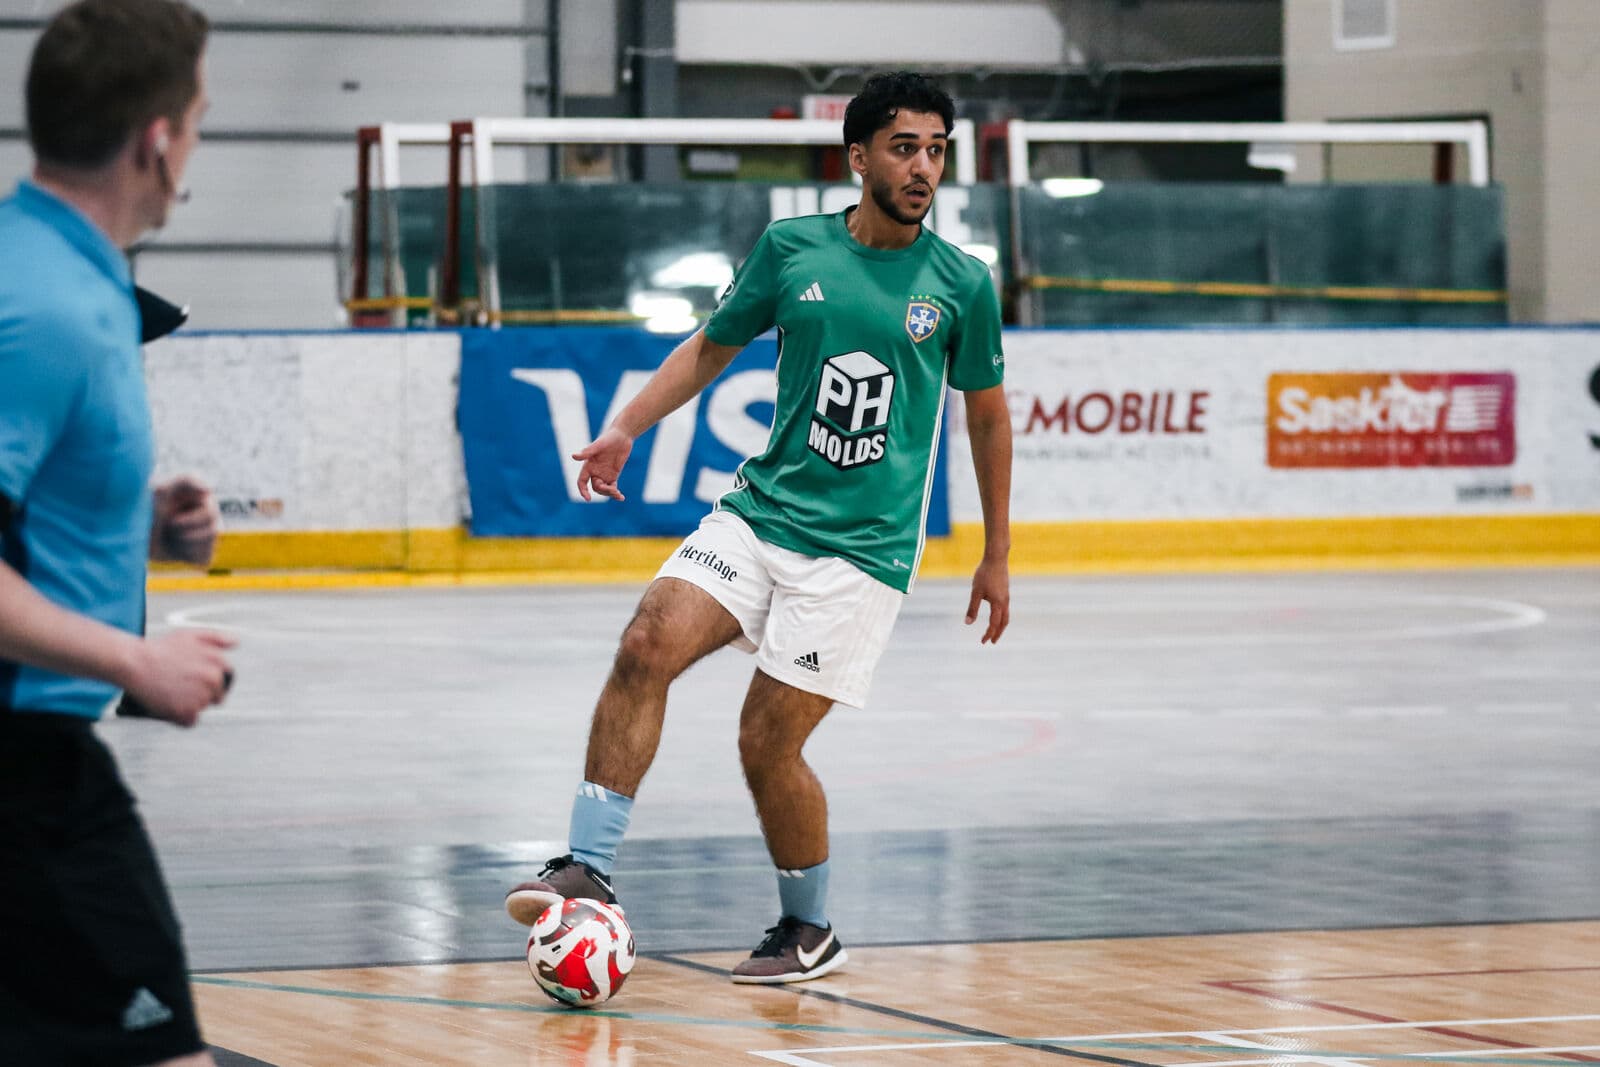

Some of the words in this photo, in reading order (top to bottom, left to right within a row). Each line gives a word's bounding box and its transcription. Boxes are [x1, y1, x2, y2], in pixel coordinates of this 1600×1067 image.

[816, 363, 894, 432] PH
[1022, 392, 1211, 434] MOBILE
[808, 420, 886, 467] MOLDS
[679, 545, 738, 582] Heritage
